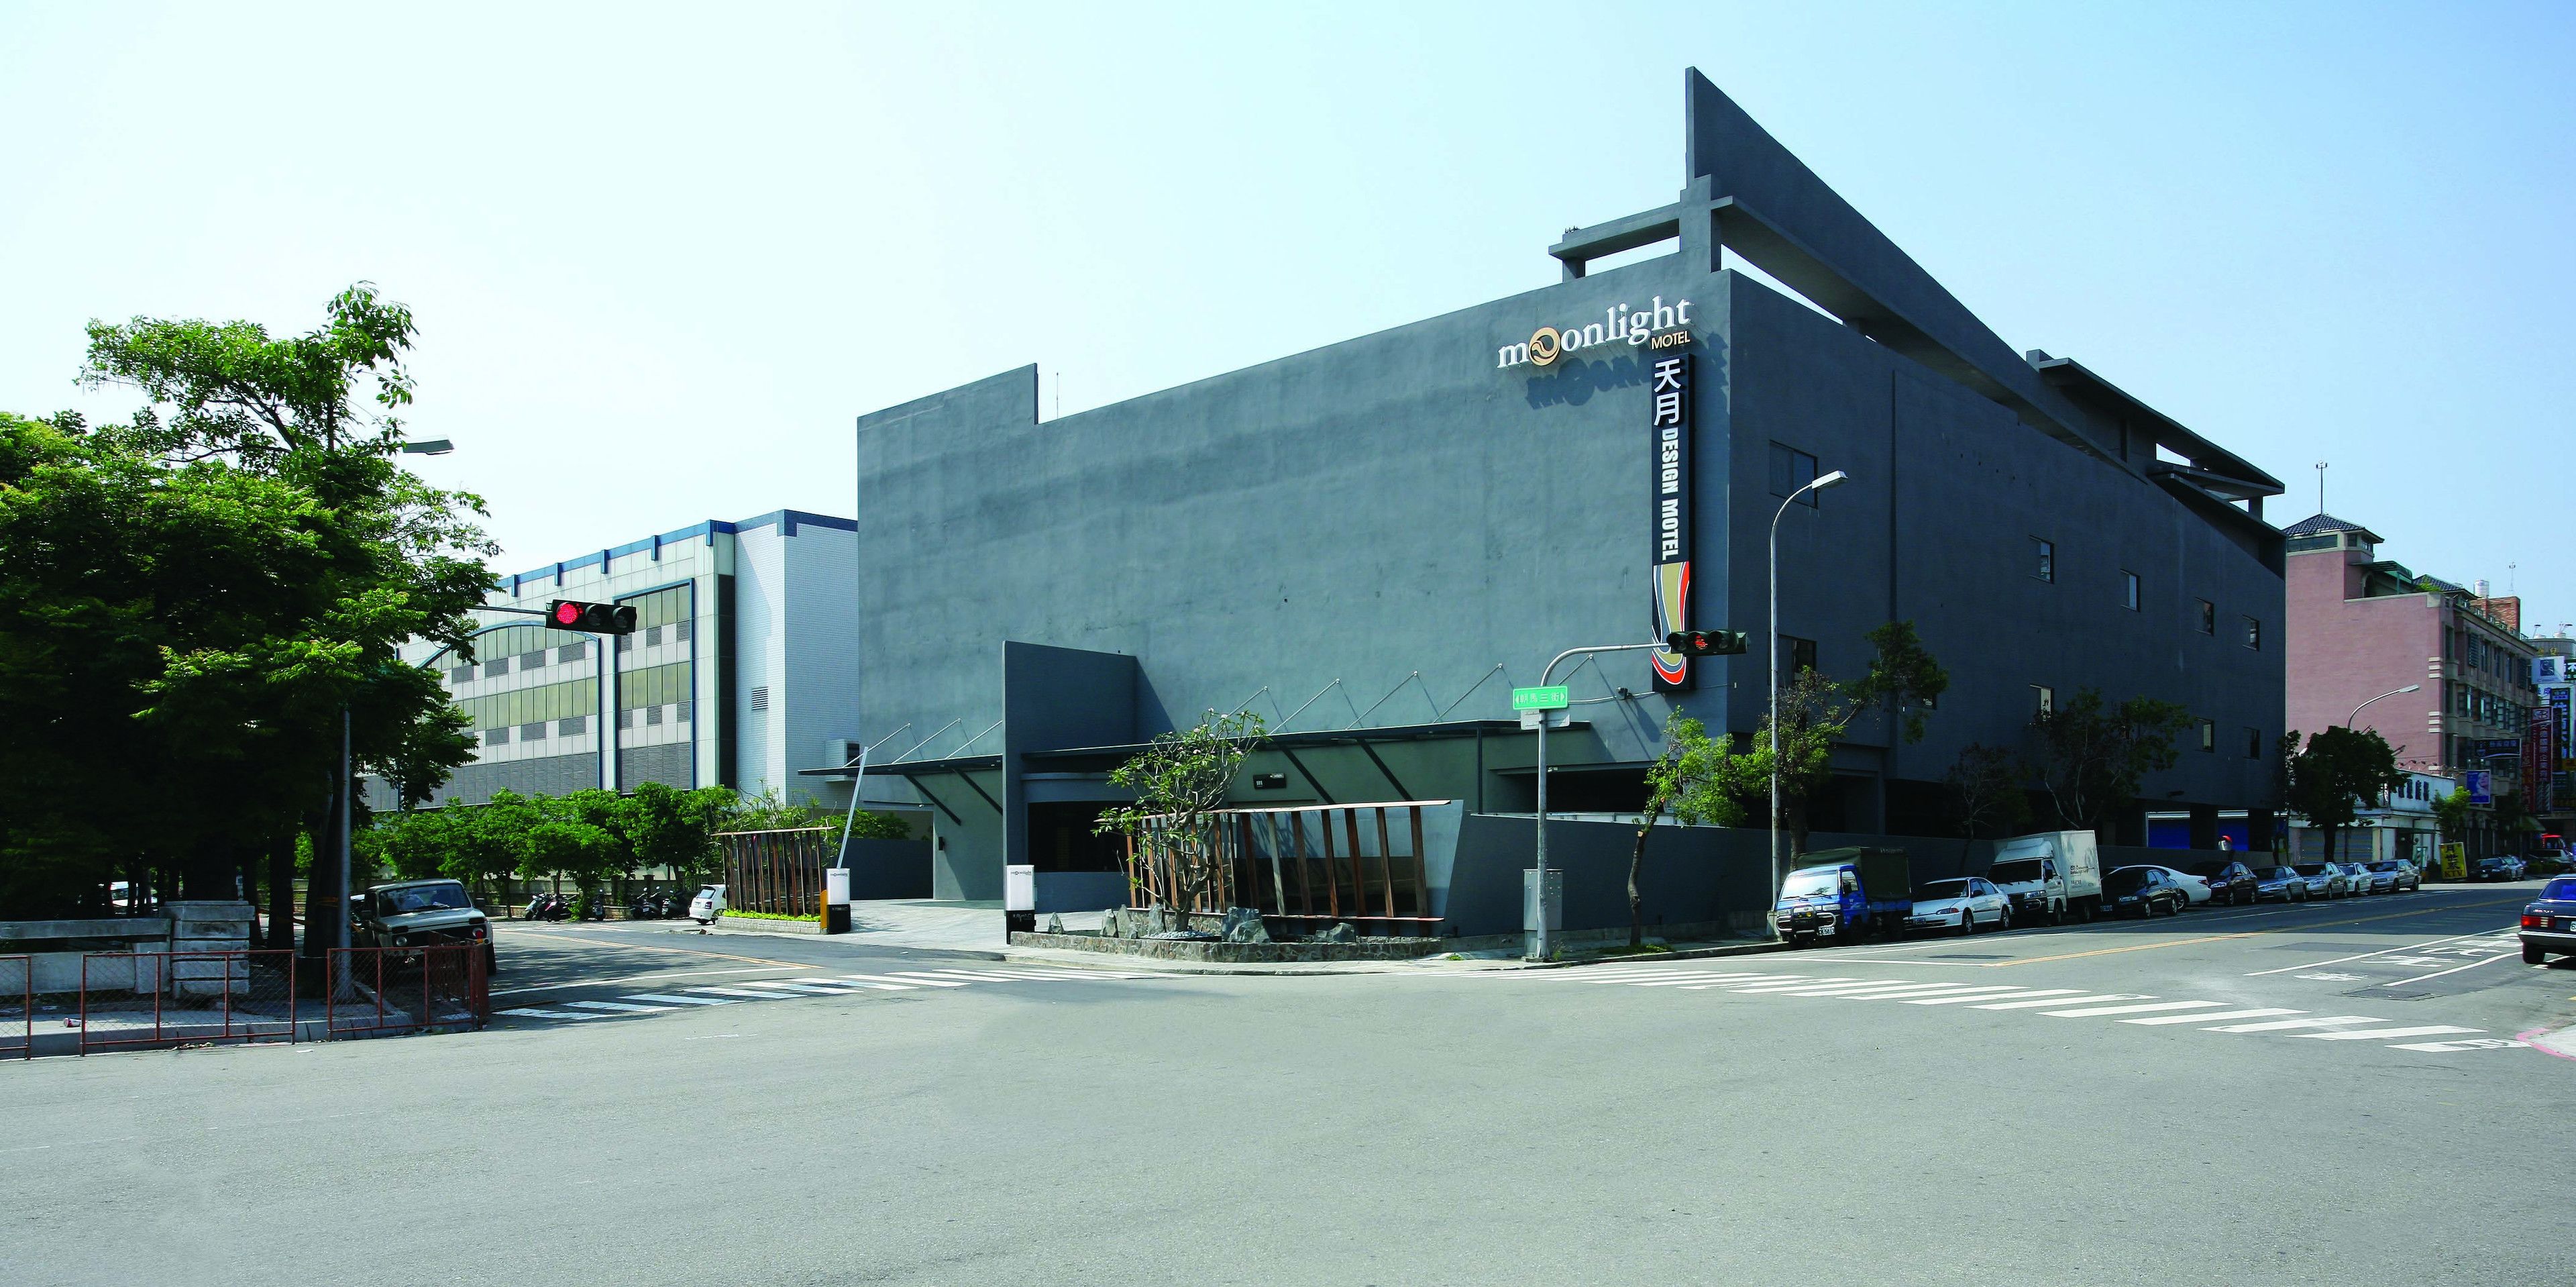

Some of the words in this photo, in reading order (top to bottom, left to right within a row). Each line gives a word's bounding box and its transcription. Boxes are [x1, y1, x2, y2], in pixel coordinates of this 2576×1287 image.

[1497, 295, 1691, 368] moonlight
[1651, 331, 1690, 350] MOTEL
[1654, 359, 1681, 426] 天月
[1662, 427, 1679, 494] DESIGN
[1662, 499, 1679, 560] MOTEL
[1519, 692, 1559, 705] 朝馬三街
